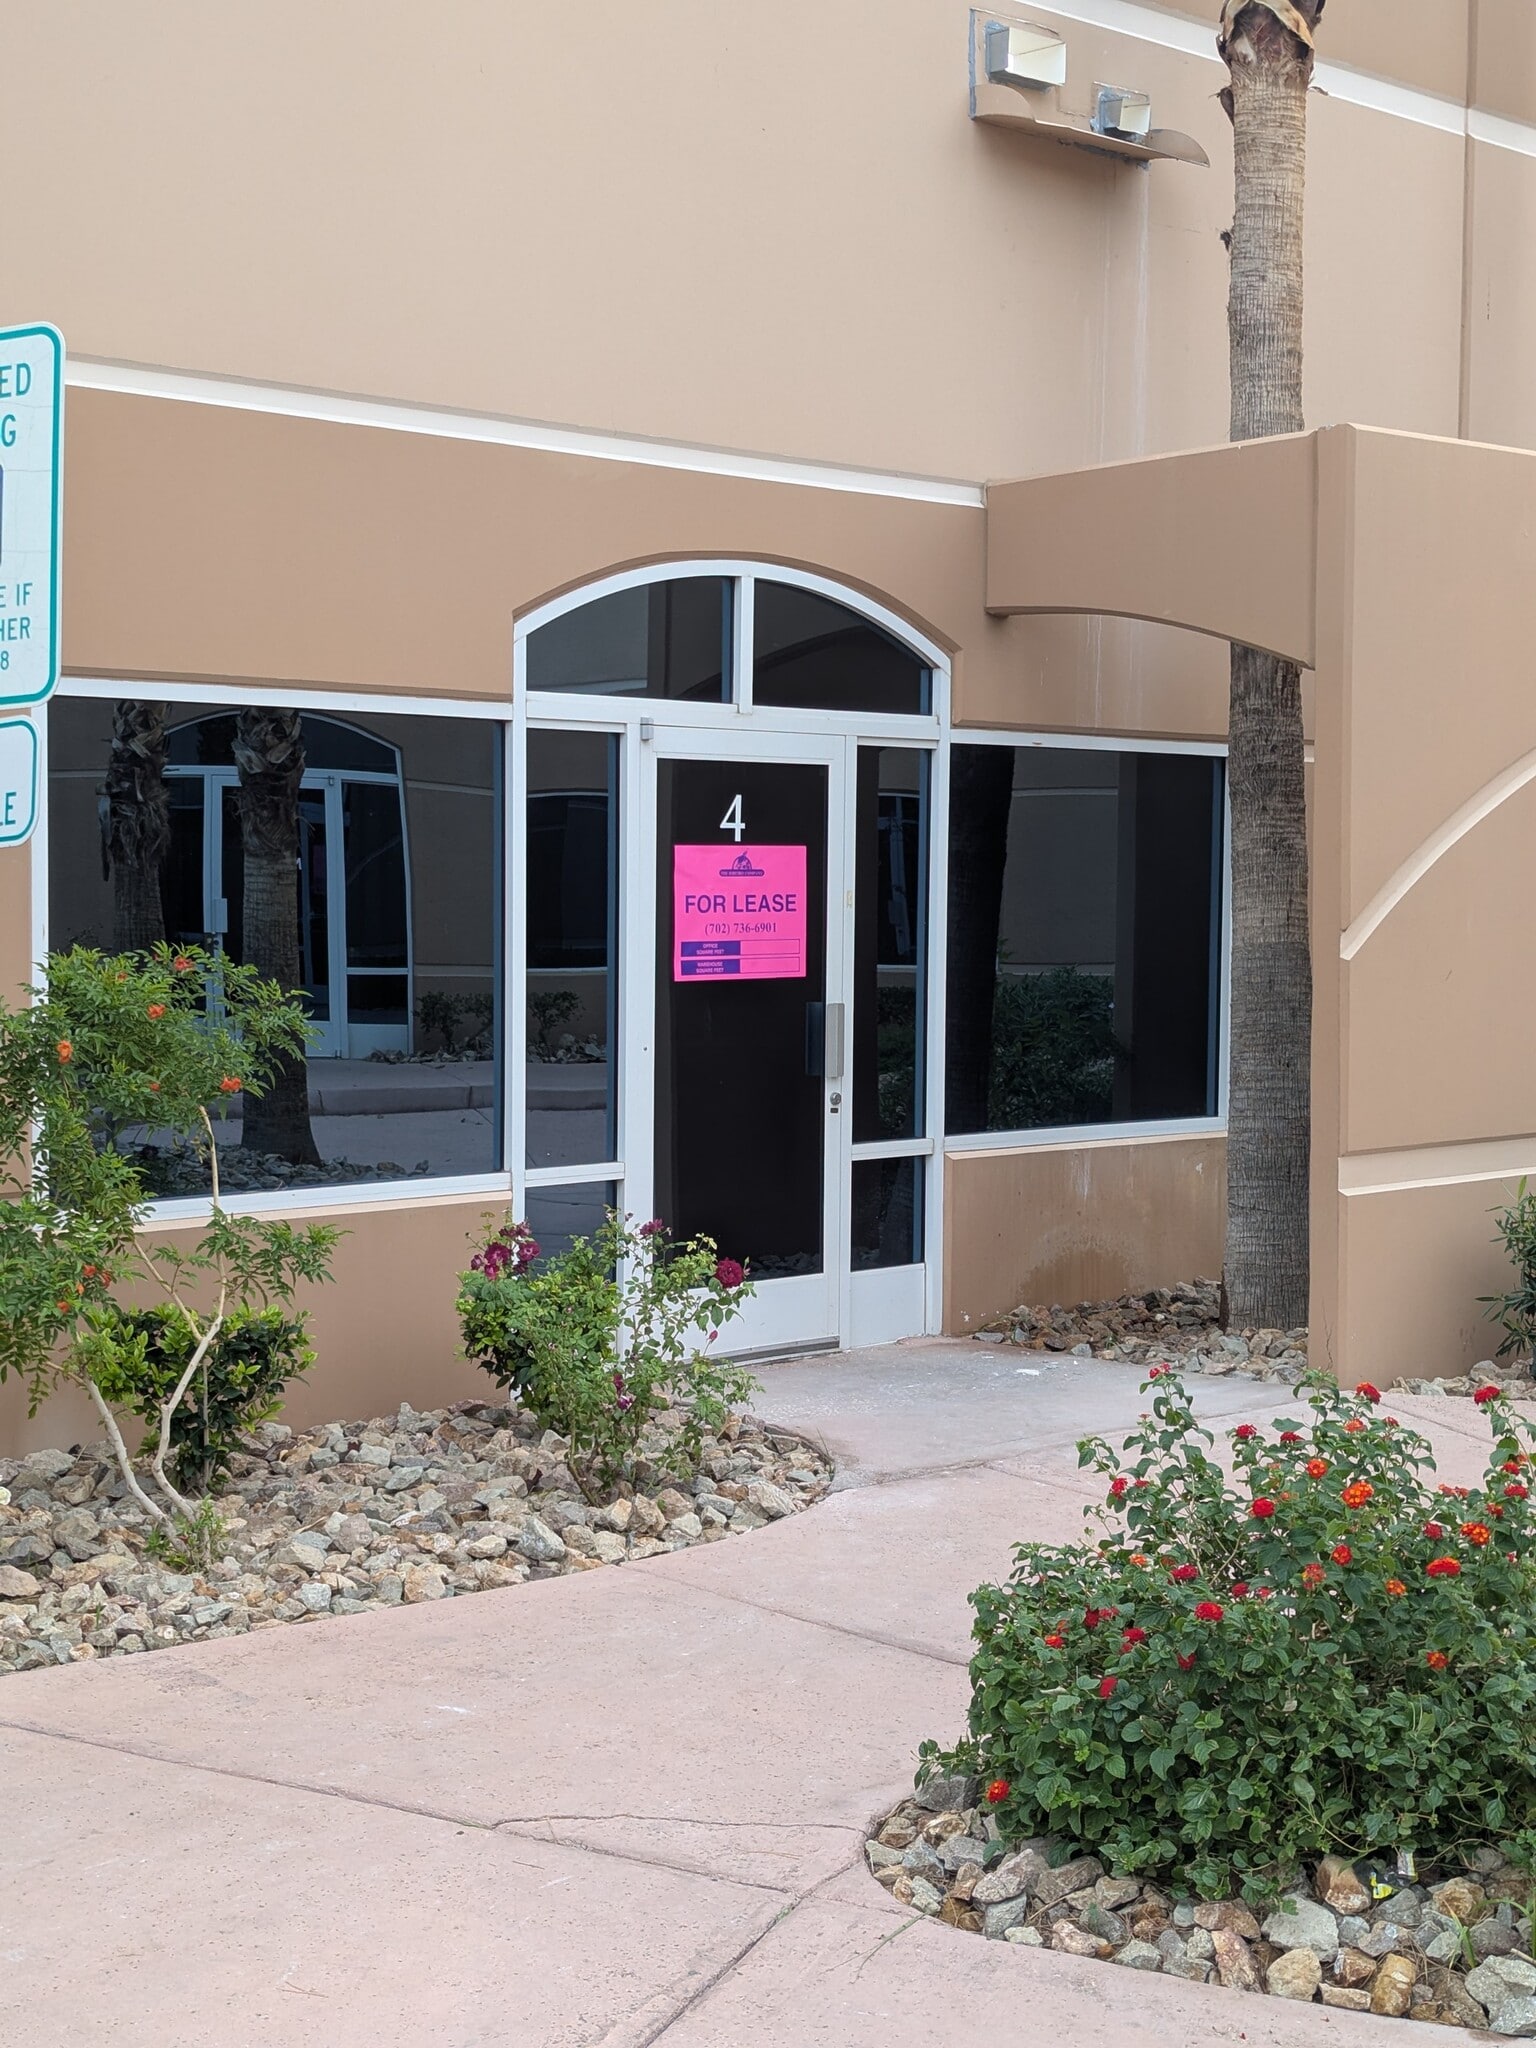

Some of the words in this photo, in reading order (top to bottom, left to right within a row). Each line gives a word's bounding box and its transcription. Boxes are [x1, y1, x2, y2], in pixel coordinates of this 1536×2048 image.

[0, 363, 31, 398] ED
[1, 414, 17, 448] G
[16, 582, 33, 606] IF
[0, 651, 9, 671] 8
[0, 792, 17, 826] E
[719, 794, 746, 842] 4
[685, 895, 726, 913] FOR
[733, 894, 797, 913] LEASE
[704, 923, 731, 937] (702)
[733, 922, 777, 934] 736-6901
